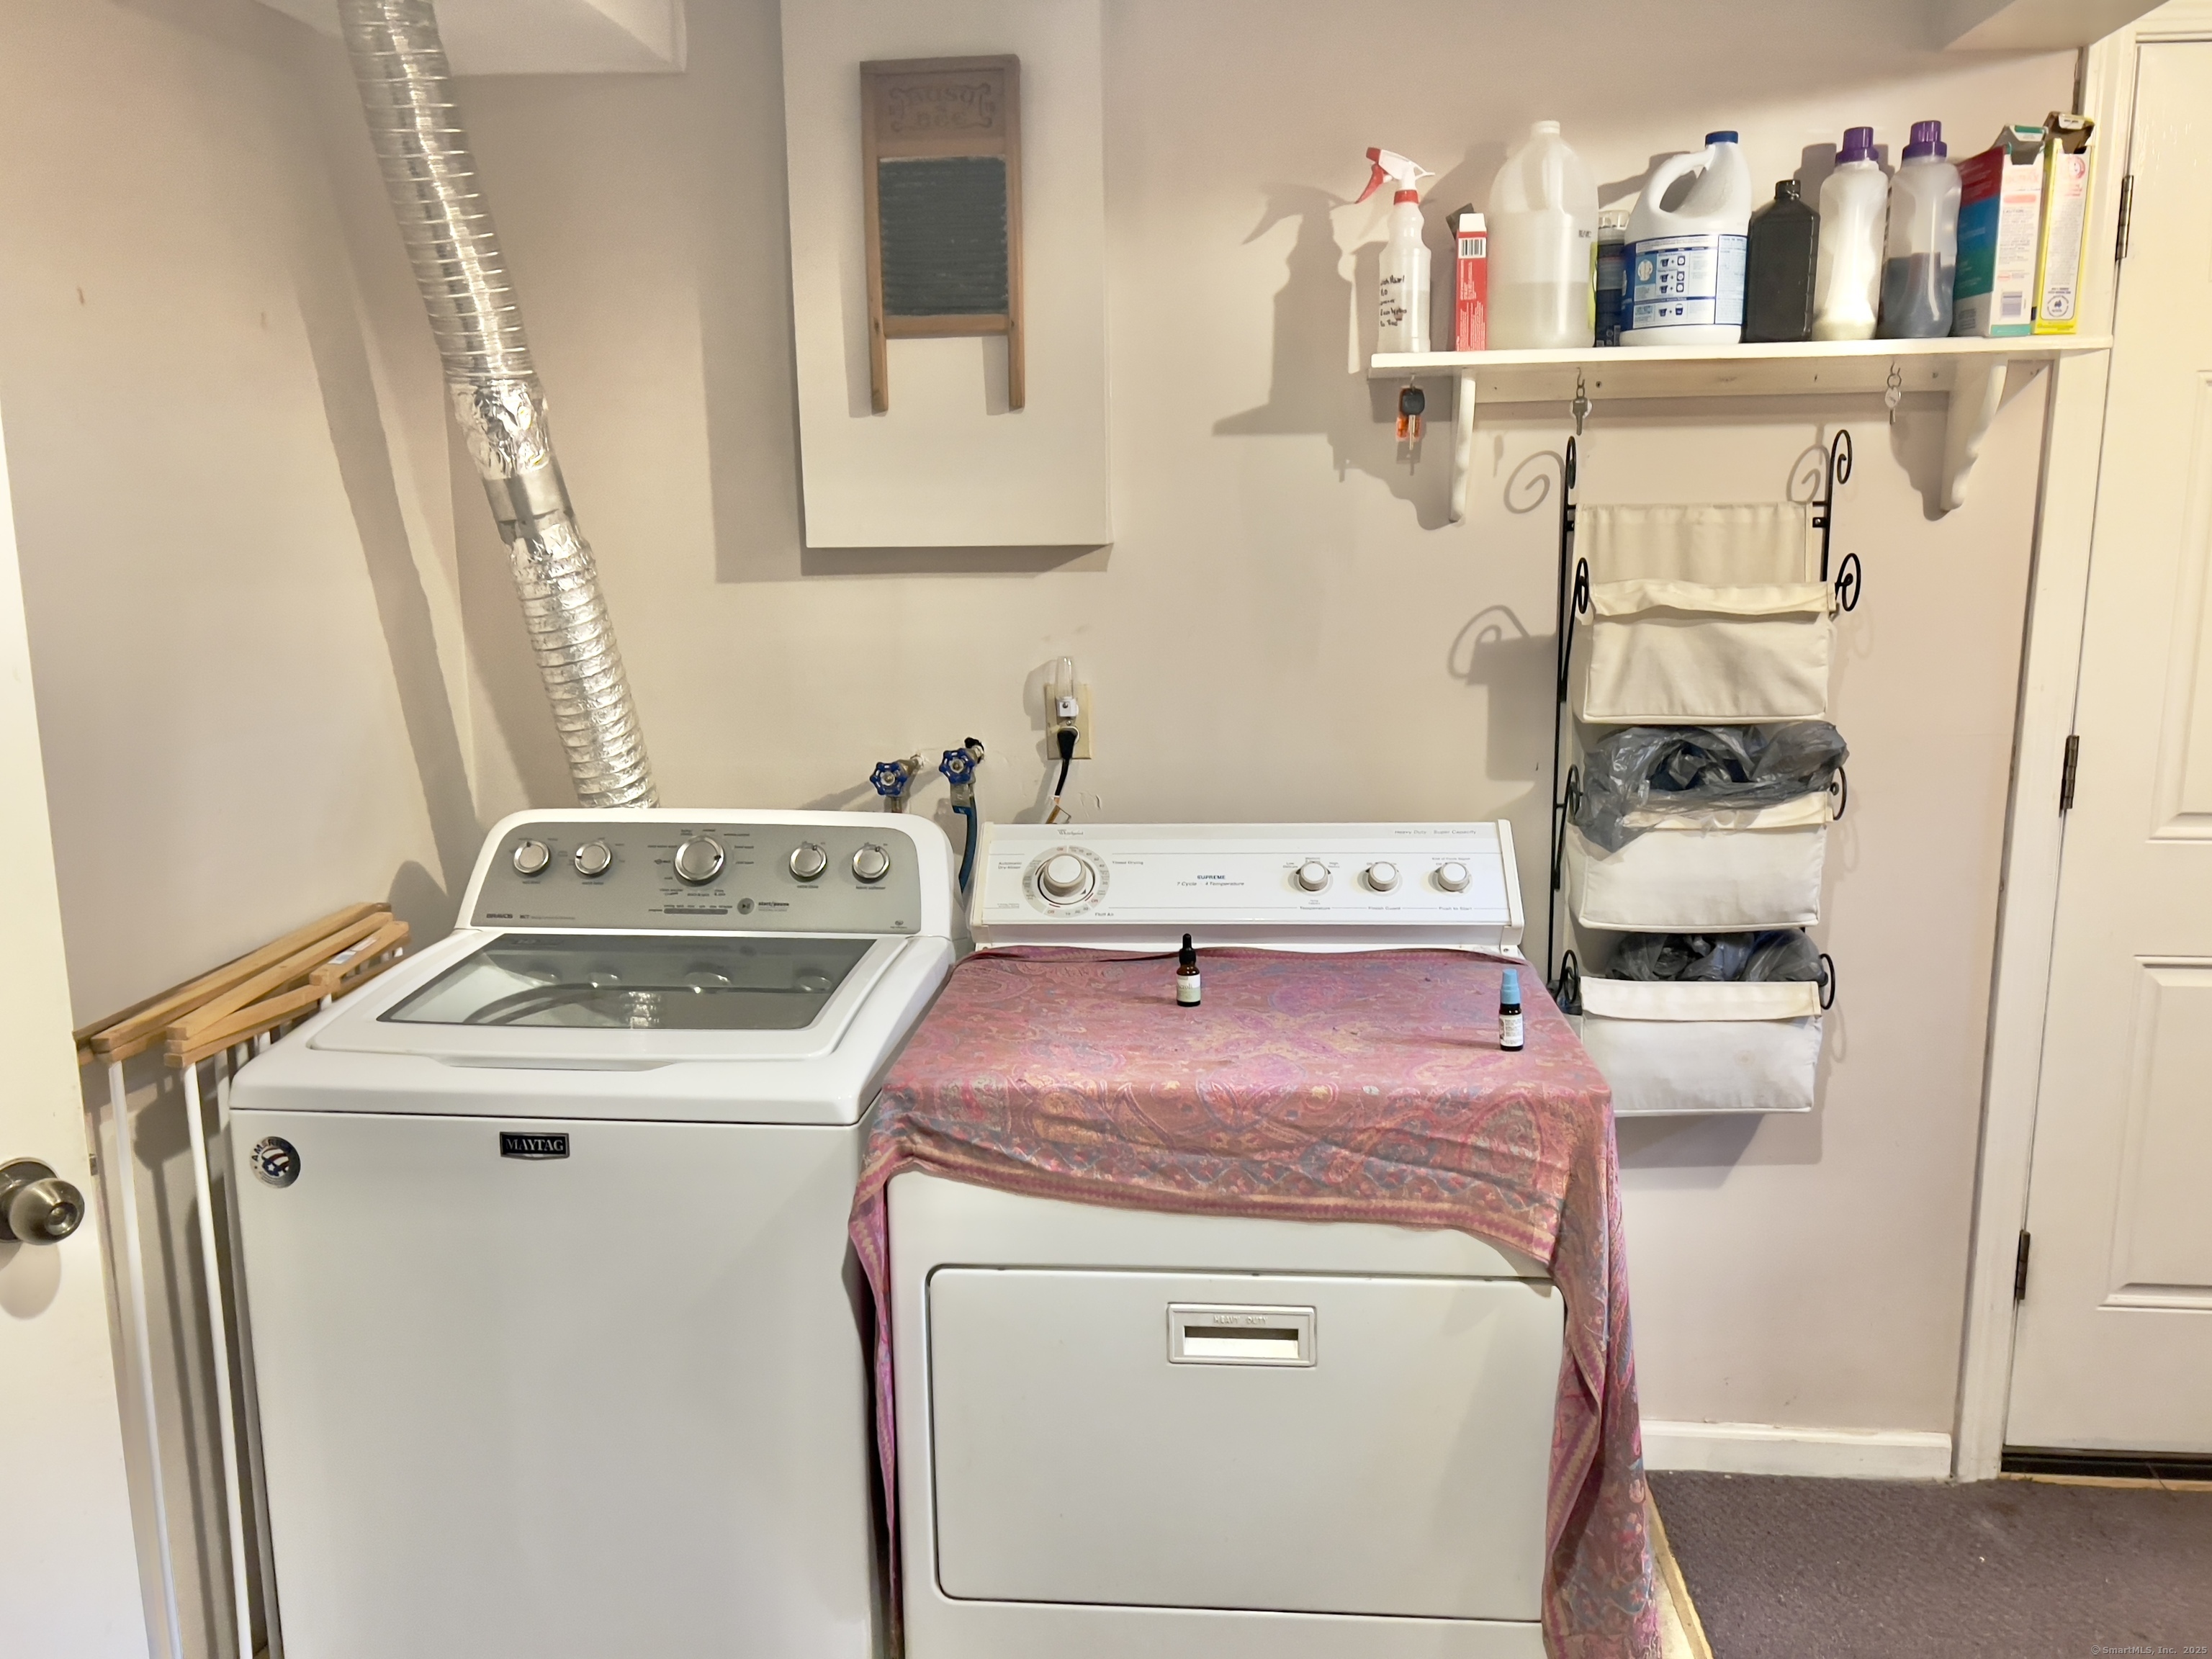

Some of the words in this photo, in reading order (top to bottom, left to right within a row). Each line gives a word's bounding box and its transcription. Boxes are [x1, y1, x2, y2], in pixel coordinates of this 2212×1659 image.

[505, 1138, 564, 1151] MAYTAG
[1213, 1315, 1241, 1324] HEAVY
[1246, 1316, 1268, 1325] DUTY
